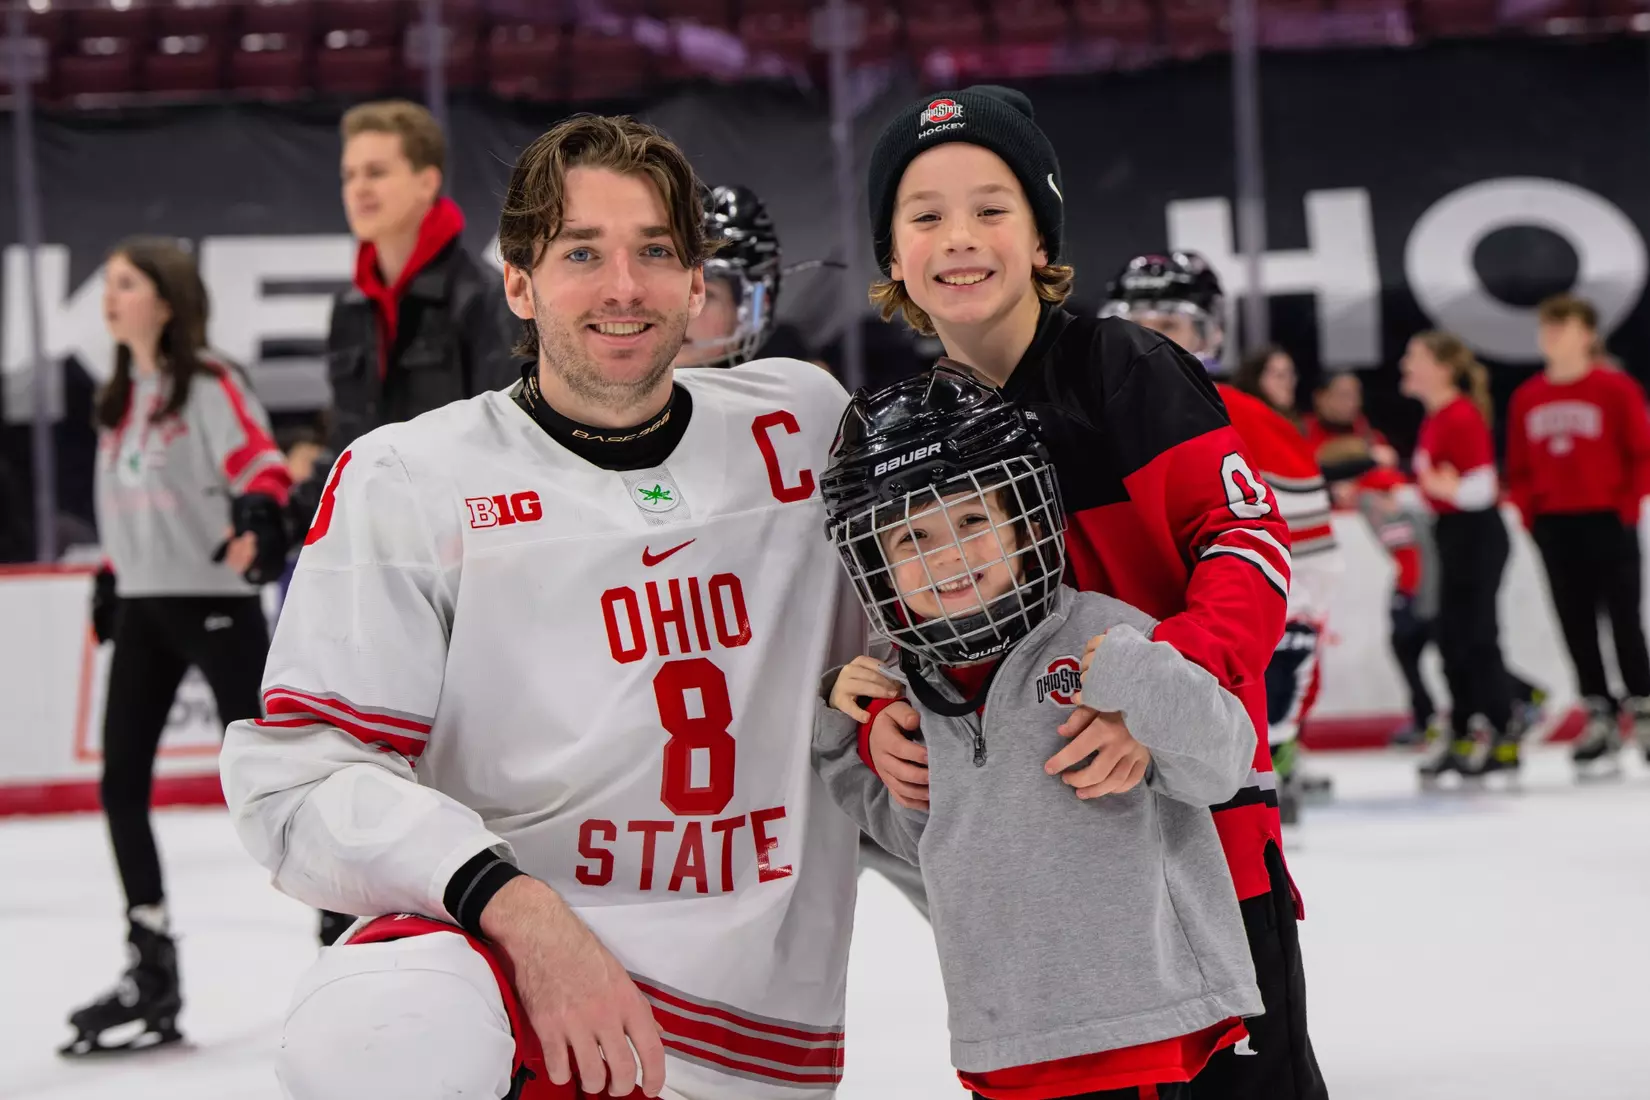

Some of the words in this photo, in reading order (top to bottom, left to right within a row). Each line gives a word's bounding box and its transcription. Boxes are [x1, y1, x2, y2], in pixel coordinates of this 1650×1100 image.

[918, 122, 966, 139] HOCKEY
[751, 409, 815, 503] C
[874, 442, 942, 477] BAUER
[600, 572, 752, 664] OHIO
[652, 657, 736, 816] 8
[575, 806, 793, 893] STATE
